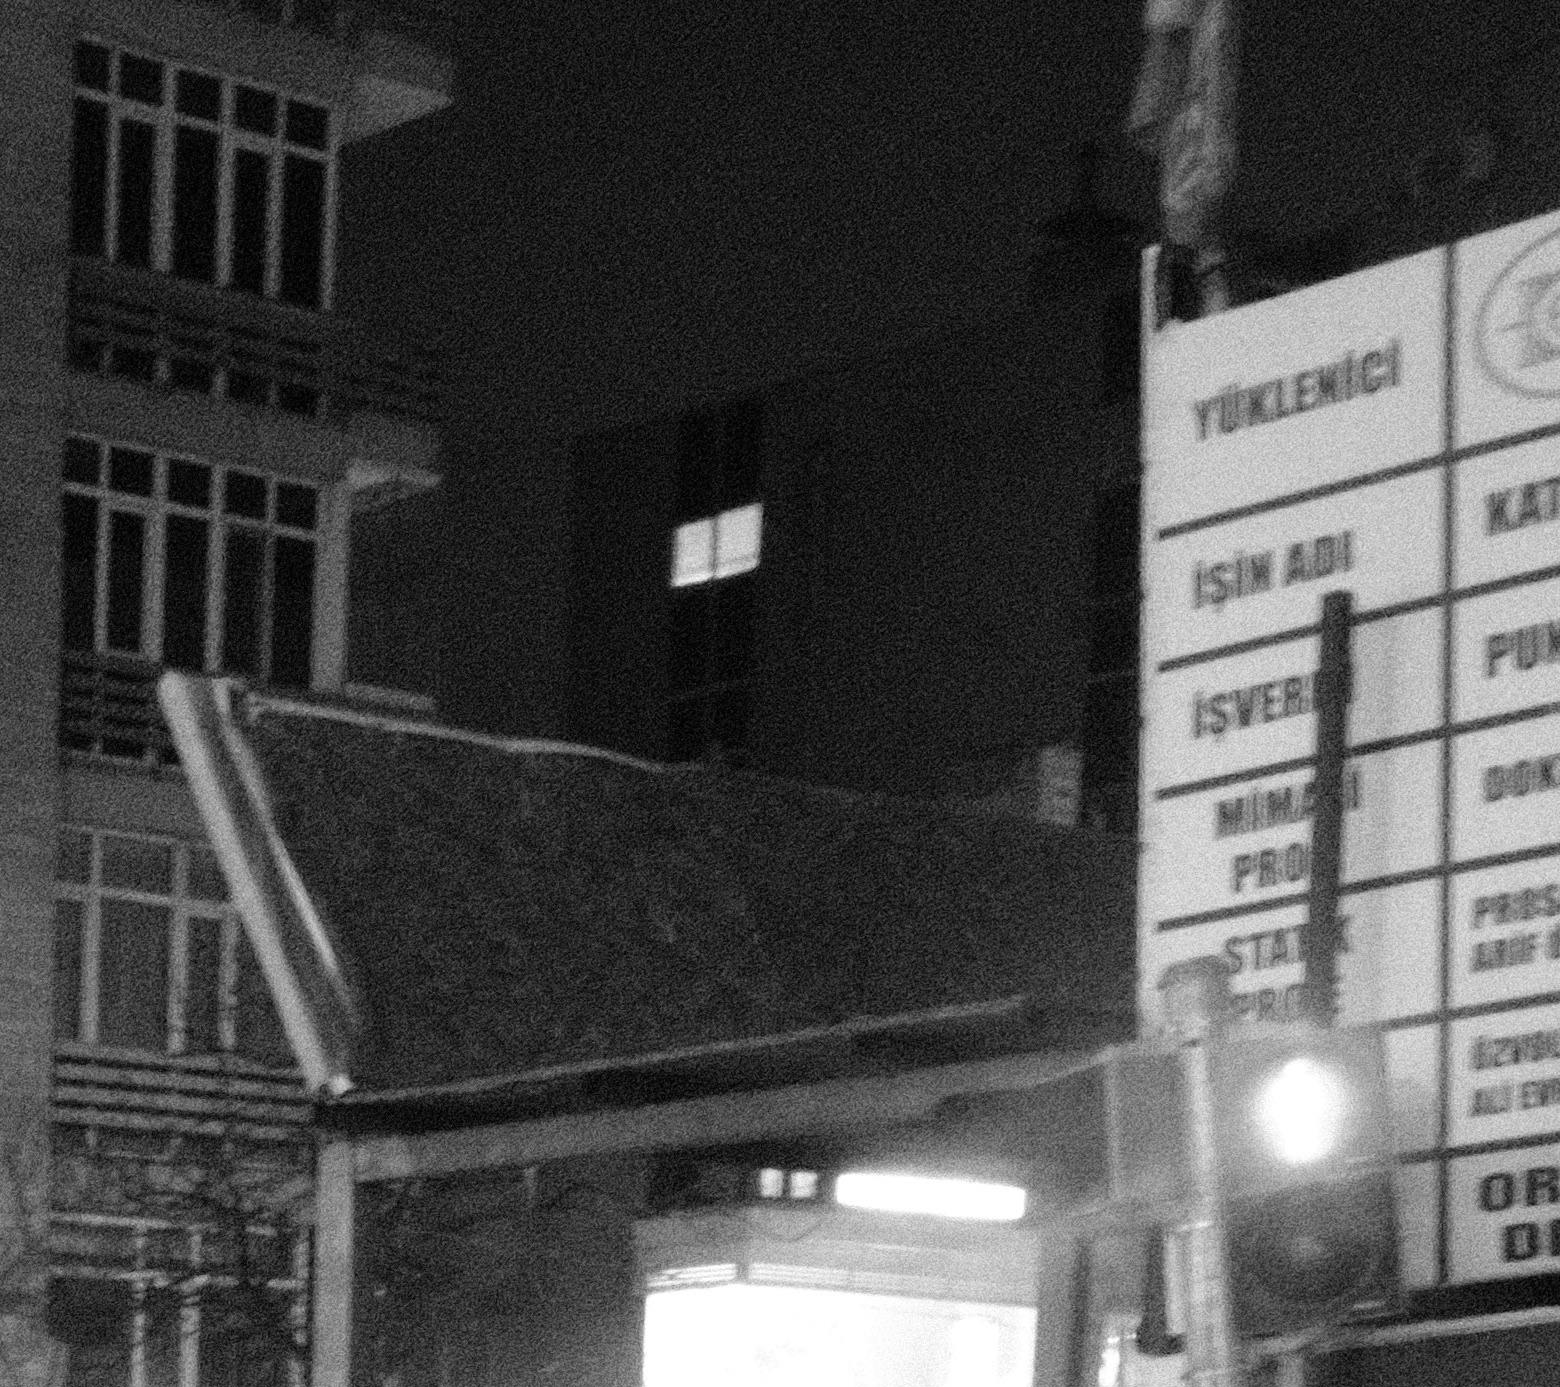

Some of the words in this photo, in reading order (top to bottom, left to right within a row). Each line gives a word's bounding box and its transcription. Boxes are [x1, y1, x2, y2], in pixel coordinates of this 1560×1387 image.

[1193, 335, 1403, 443] YÜKLENİCİ
[1194, 548, 1274, 612] İŞİN
[1281, 529, 1353, 587] ADI
[1191, 672, 1318, 745] İŞVER
[1230, 842, 1312, 894] PRO
